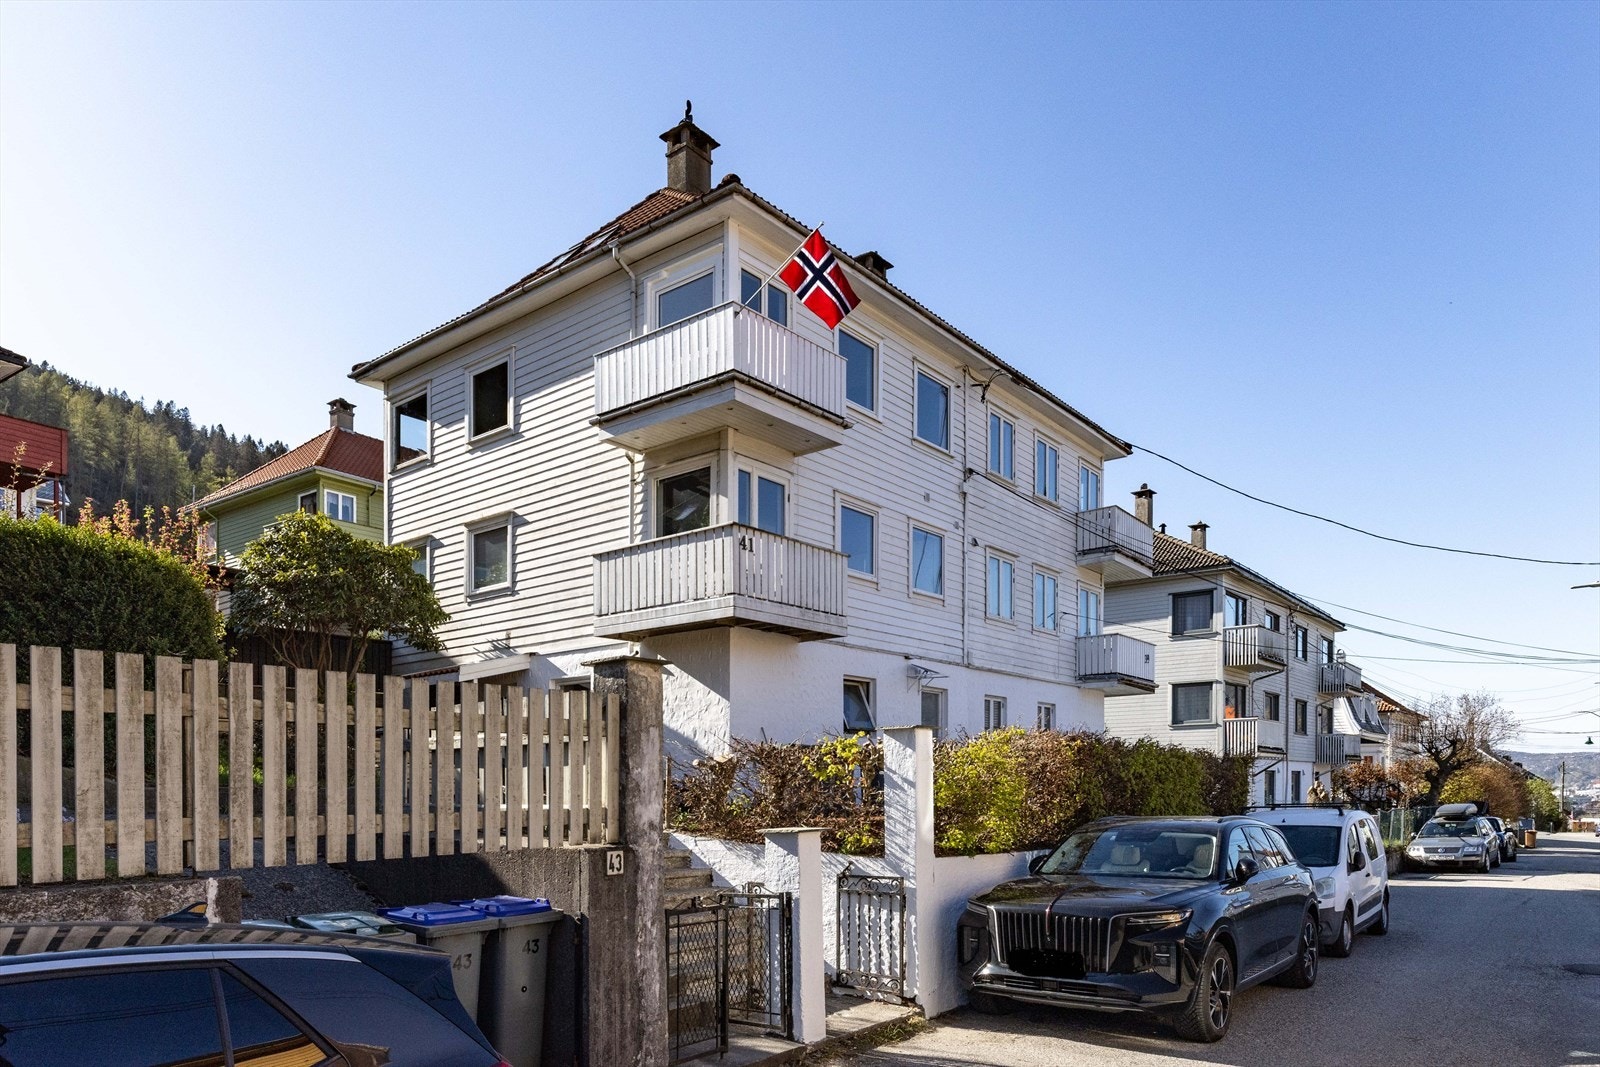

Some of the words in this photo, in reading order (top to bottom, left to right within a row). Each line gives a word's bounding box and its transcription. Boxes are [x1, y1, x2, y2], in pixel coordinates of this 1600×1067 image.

[739, 535, 754, 553] 41
[609, 853, 622, 872] 43
[522, 938, 540, 954] 43
[453, 953, 472, 970] 43
